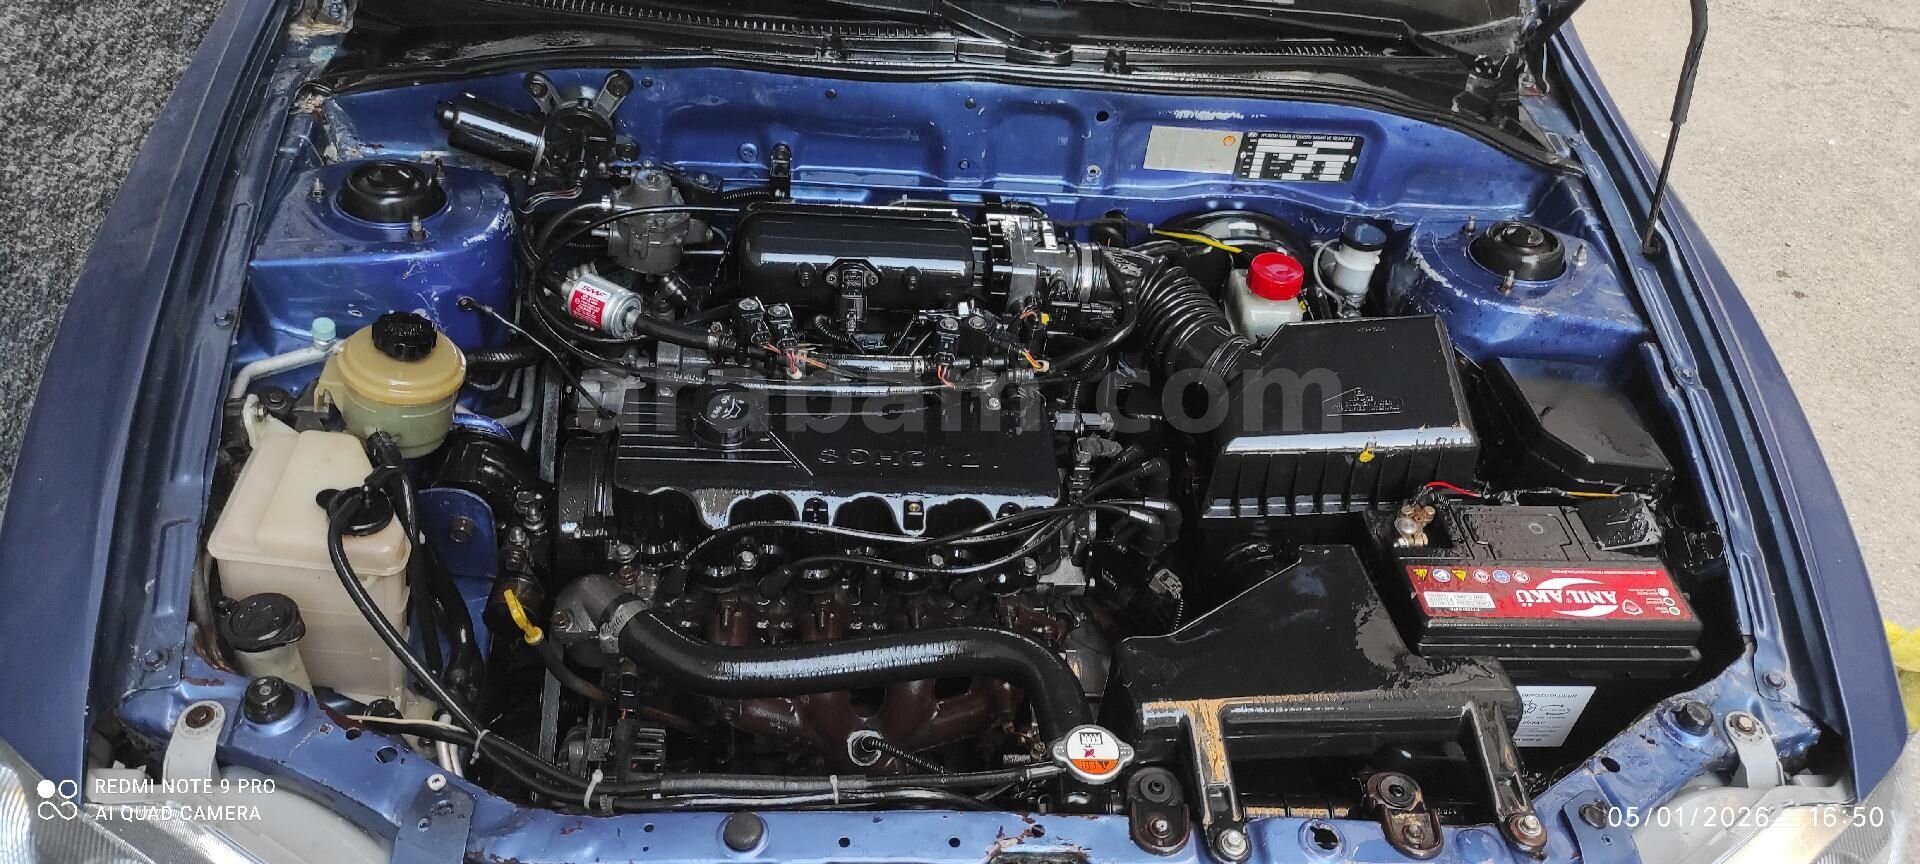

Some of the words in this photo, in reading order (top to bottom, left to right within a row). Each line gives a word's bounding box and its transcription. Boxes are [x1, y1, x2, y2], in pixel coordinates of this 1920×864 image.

[817, 448, 926, 467] SOHC
[1515, 589, 1562, 607] AKÜ
[1566, 589, 1617, 604] ANIL
